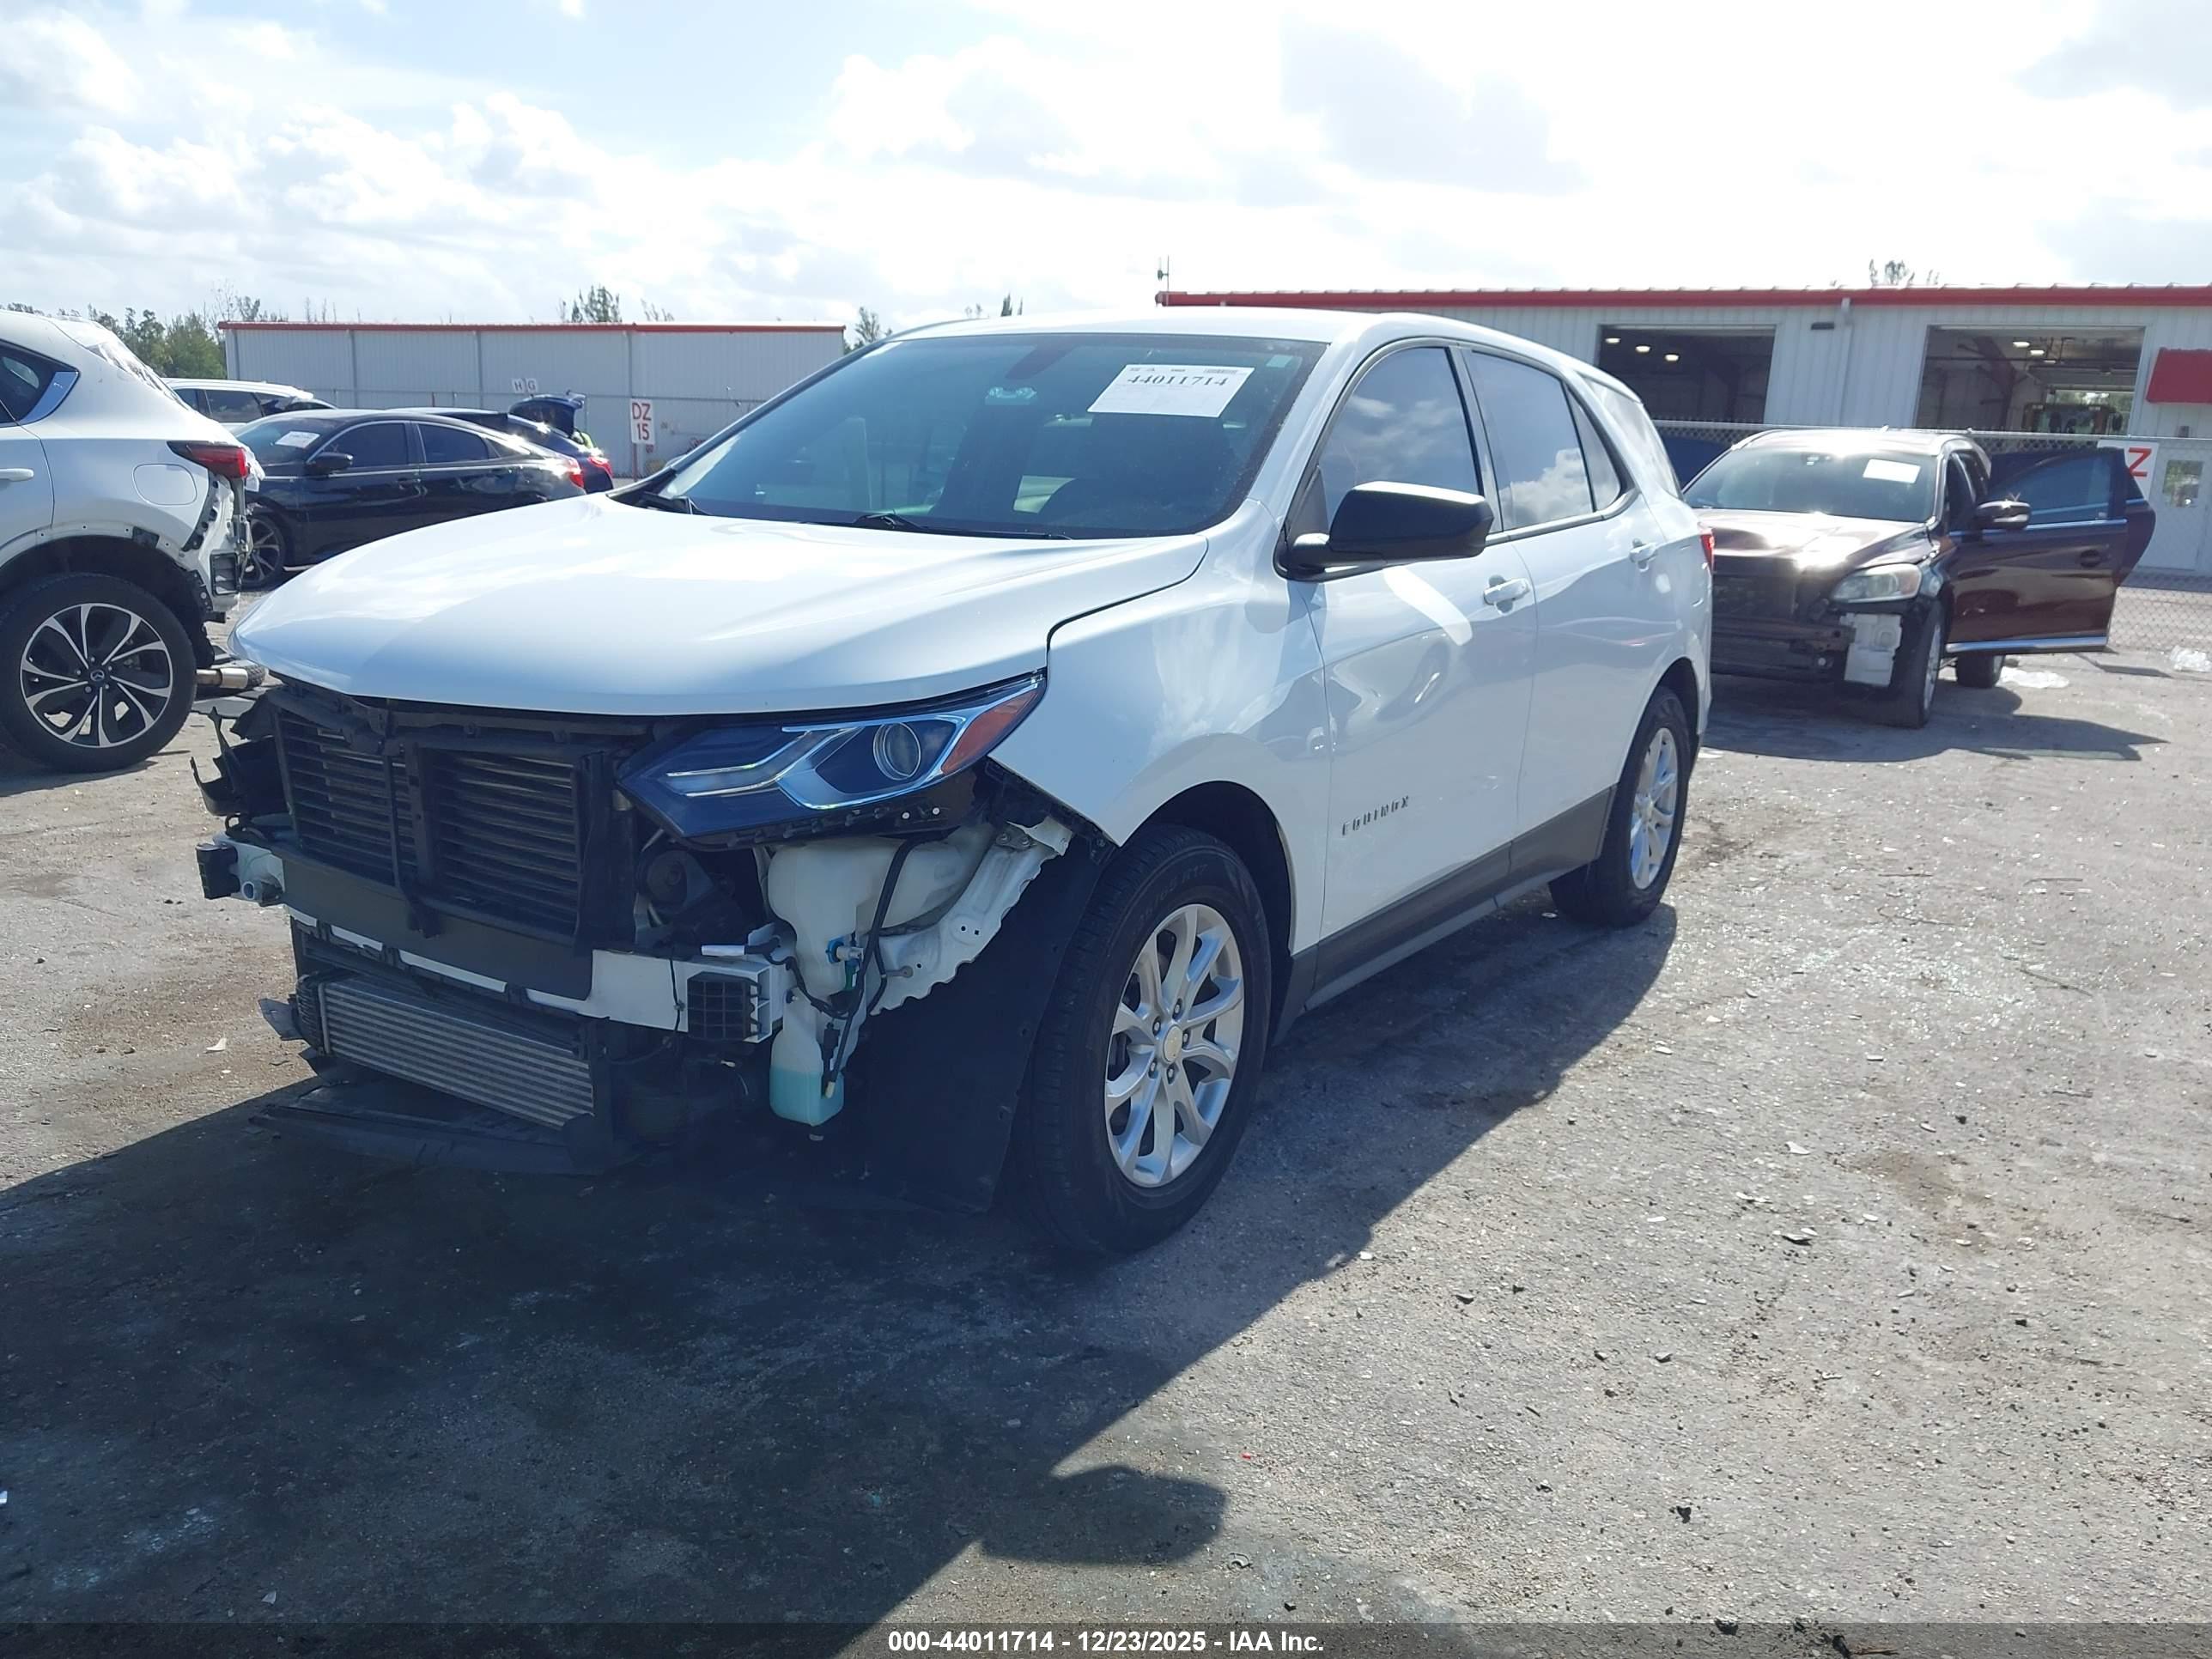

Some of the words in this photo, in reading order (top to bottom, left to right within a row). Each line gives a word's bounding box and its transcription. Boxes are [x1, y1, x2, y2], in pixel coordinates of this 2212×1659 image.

[1127, 374, 1229, 386] 44011714
[632, 402, 652, 421] DZ
[637, 423, 650, 441] 15
